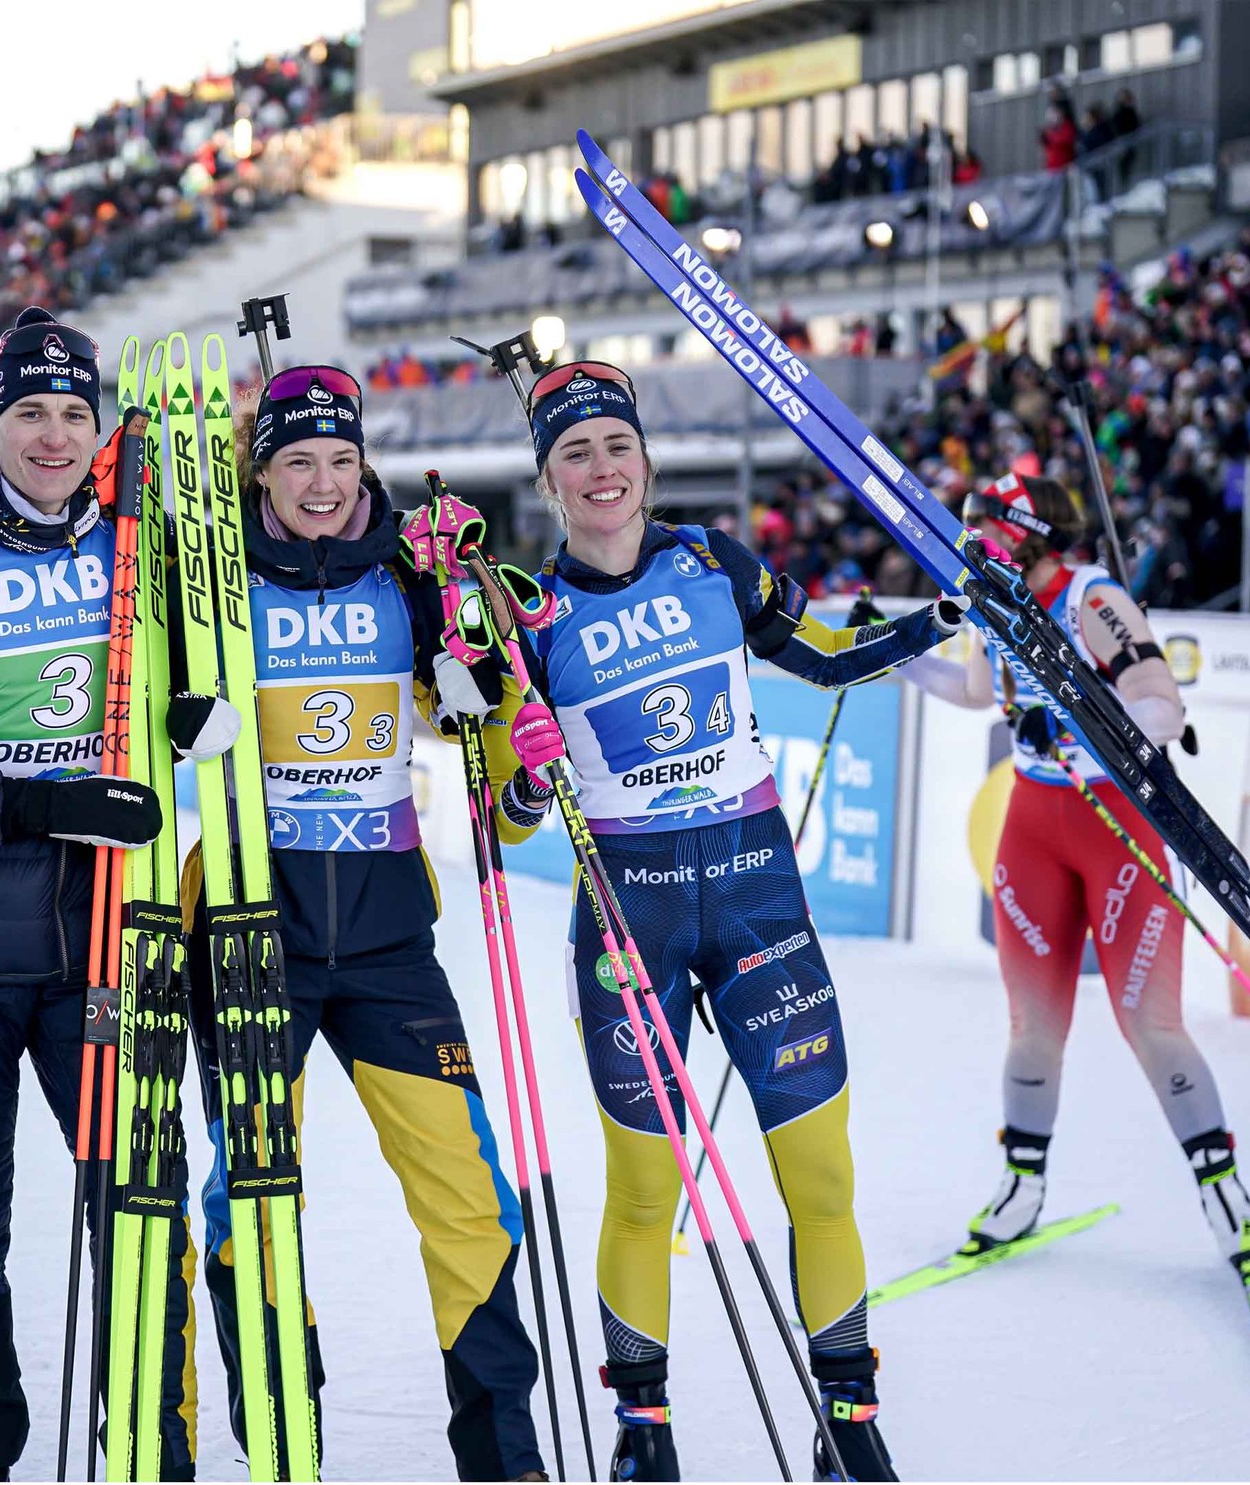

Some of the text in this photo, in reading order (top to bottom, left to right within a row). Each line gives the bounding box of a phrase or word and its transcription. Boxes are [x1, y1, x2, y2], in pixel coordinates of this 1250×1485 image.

[672, 242, 810, 385] SALOMON
[670, 281, 810, 424] SALOMON
[20, 364, 92, 383] Monitor ERP
[285, 406, 355, 424] Monitor ERP
[546, 390, 626, 423] Monitor ERP
[134, 483, 142, 515] ONE
[443, 499, 458, 526] LEKI
[147, 435, 165, 630] FISCHER
[174, 429, 210, 629] FISCHER
[210, 433, 248, 632] FISCHER
[542, 559, 555, 576] TG
[690, 543, 721, 570] ATG
[0, 608, 110, 637] Das kann Bank
[267, 604, 378, 649] DKB
[579, 595, 693, 666] DKB
[1099, 607, 1136, 648] BKW
[268, 651, 378, 668] Das kann Bank
[594, 637, 700, 685] Das kann Bank
[978, 626, 1070, 721] SALOMON
[30, 652, 94, 730] 3
[297, 690, 396, 755] 3 3
[640, 683, 731, 754] 3 4
[267, 766, 382, 785] OBERHOF
[622, 750, 727, 788] OBERHOF
[270, 811, 295, 825] MW
[315, 813, 324, 850] THE NEW
[327, 811, 391, 851] X3
[555, 779, 584, 845] LEKI
[733, 847, 775, 874] ERP
[136, 911, 182, 924] FISCHER
[211, 909, 279, 924] FISCHER
[998, 886, 1052, 958] sunrise
[1101, 863, 1139, 945] odlo
[738, 930, 810, 975] Autoexperten
[1121, 902, 1169, 1010] RAIFFEISEN
[122, 940, 137, 1074] FISCHER
[746, 983, 836, 1032] SVEASKOG
[777, 1034, 830, 1067] ATG
[128, 1196, 176, 1208] FISCHER
[232, 1175, 299, 1189] FISCHER
